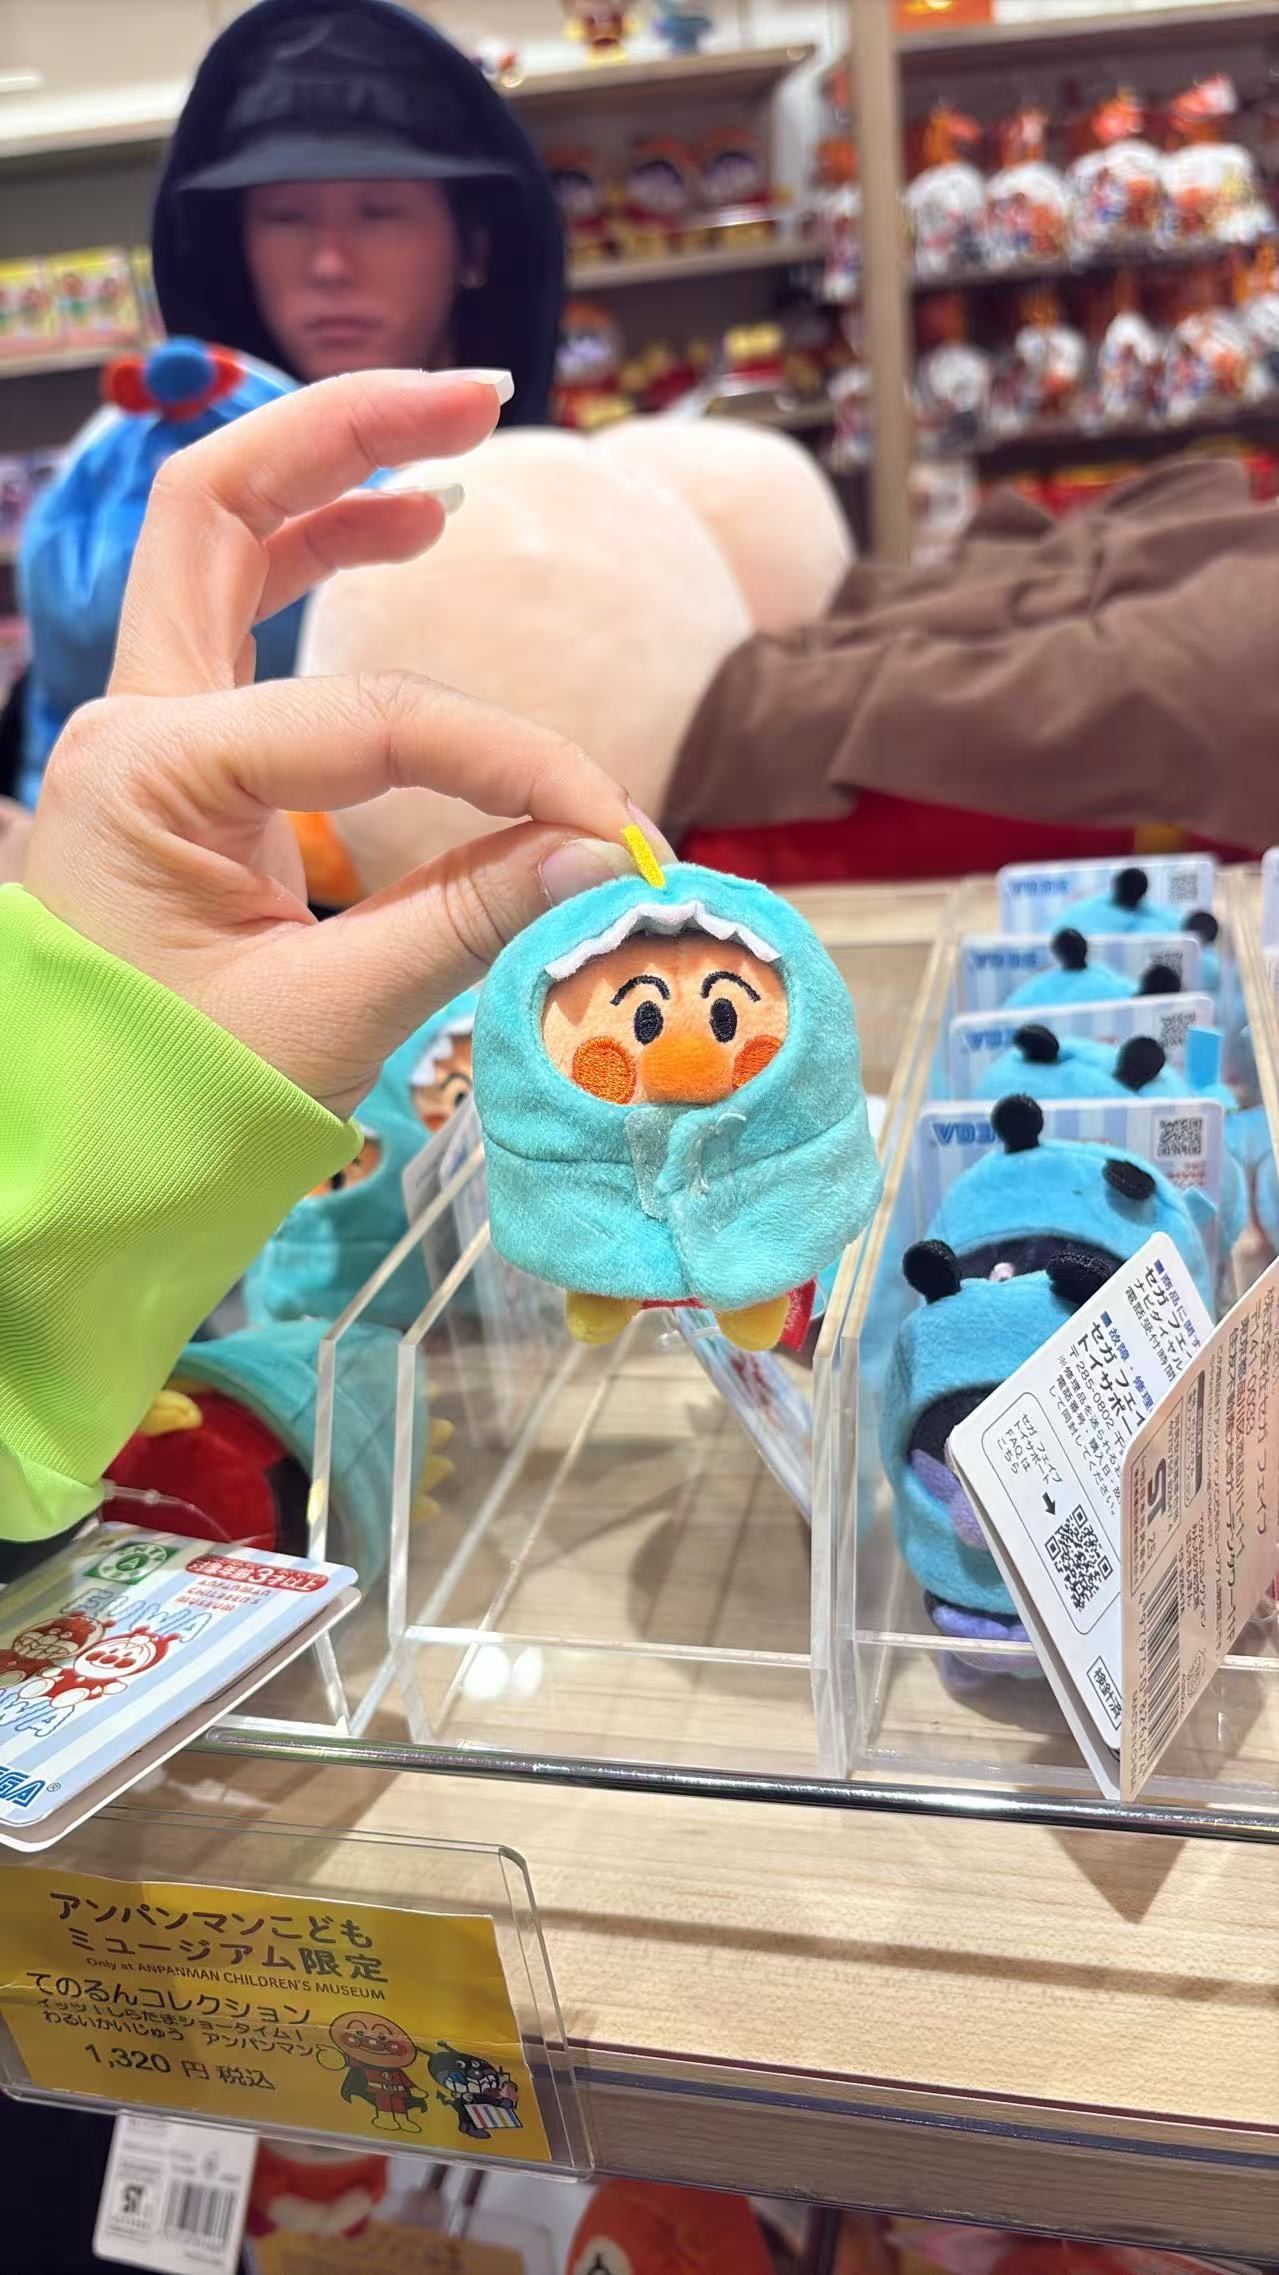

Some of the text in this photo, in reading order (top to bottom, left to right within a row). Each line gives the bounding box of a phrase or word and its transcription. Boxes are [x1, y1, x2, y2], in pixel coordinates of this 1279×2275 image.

[966, 1027, 1017, 1051] EGA
[932, 1121, 996, 1145] EGA
[1144, 1266, 1169, 1307] セガ
[1090, 1321, 1117, 1365] セガ
[1124, 1286, 1176, 1382] 電話受付時間
[1134, 1279, 1185, 1372] ナビダイヤル
[1108, 1327, 1155, 1412] 故障・修理
[1021, 1413, 1038, 1437] セガ
[1055, 1374, 1124, 1504] 電話番号・購入日・故
[996, 1437, 1020, 1474] こちら
[1013, 1420, 1050, 1484] トイサポート
[49, 1891, 374, 1948] アンパンマンこども
[68, 1927, 389, 1984] ミュージアム限定
[26, 1972, 312, 2024] てのるんコレクション
[137, 1961, 220, 1982] ANPANMAN
[222, 1970, 312, 1993] CHILDREN'S
[314, 1982, 386, 2001] MUSEUM
[85, 2042, 275, 2091] 1,320 円 税込
[205, 2032, 314, 2058] アンパンマン
